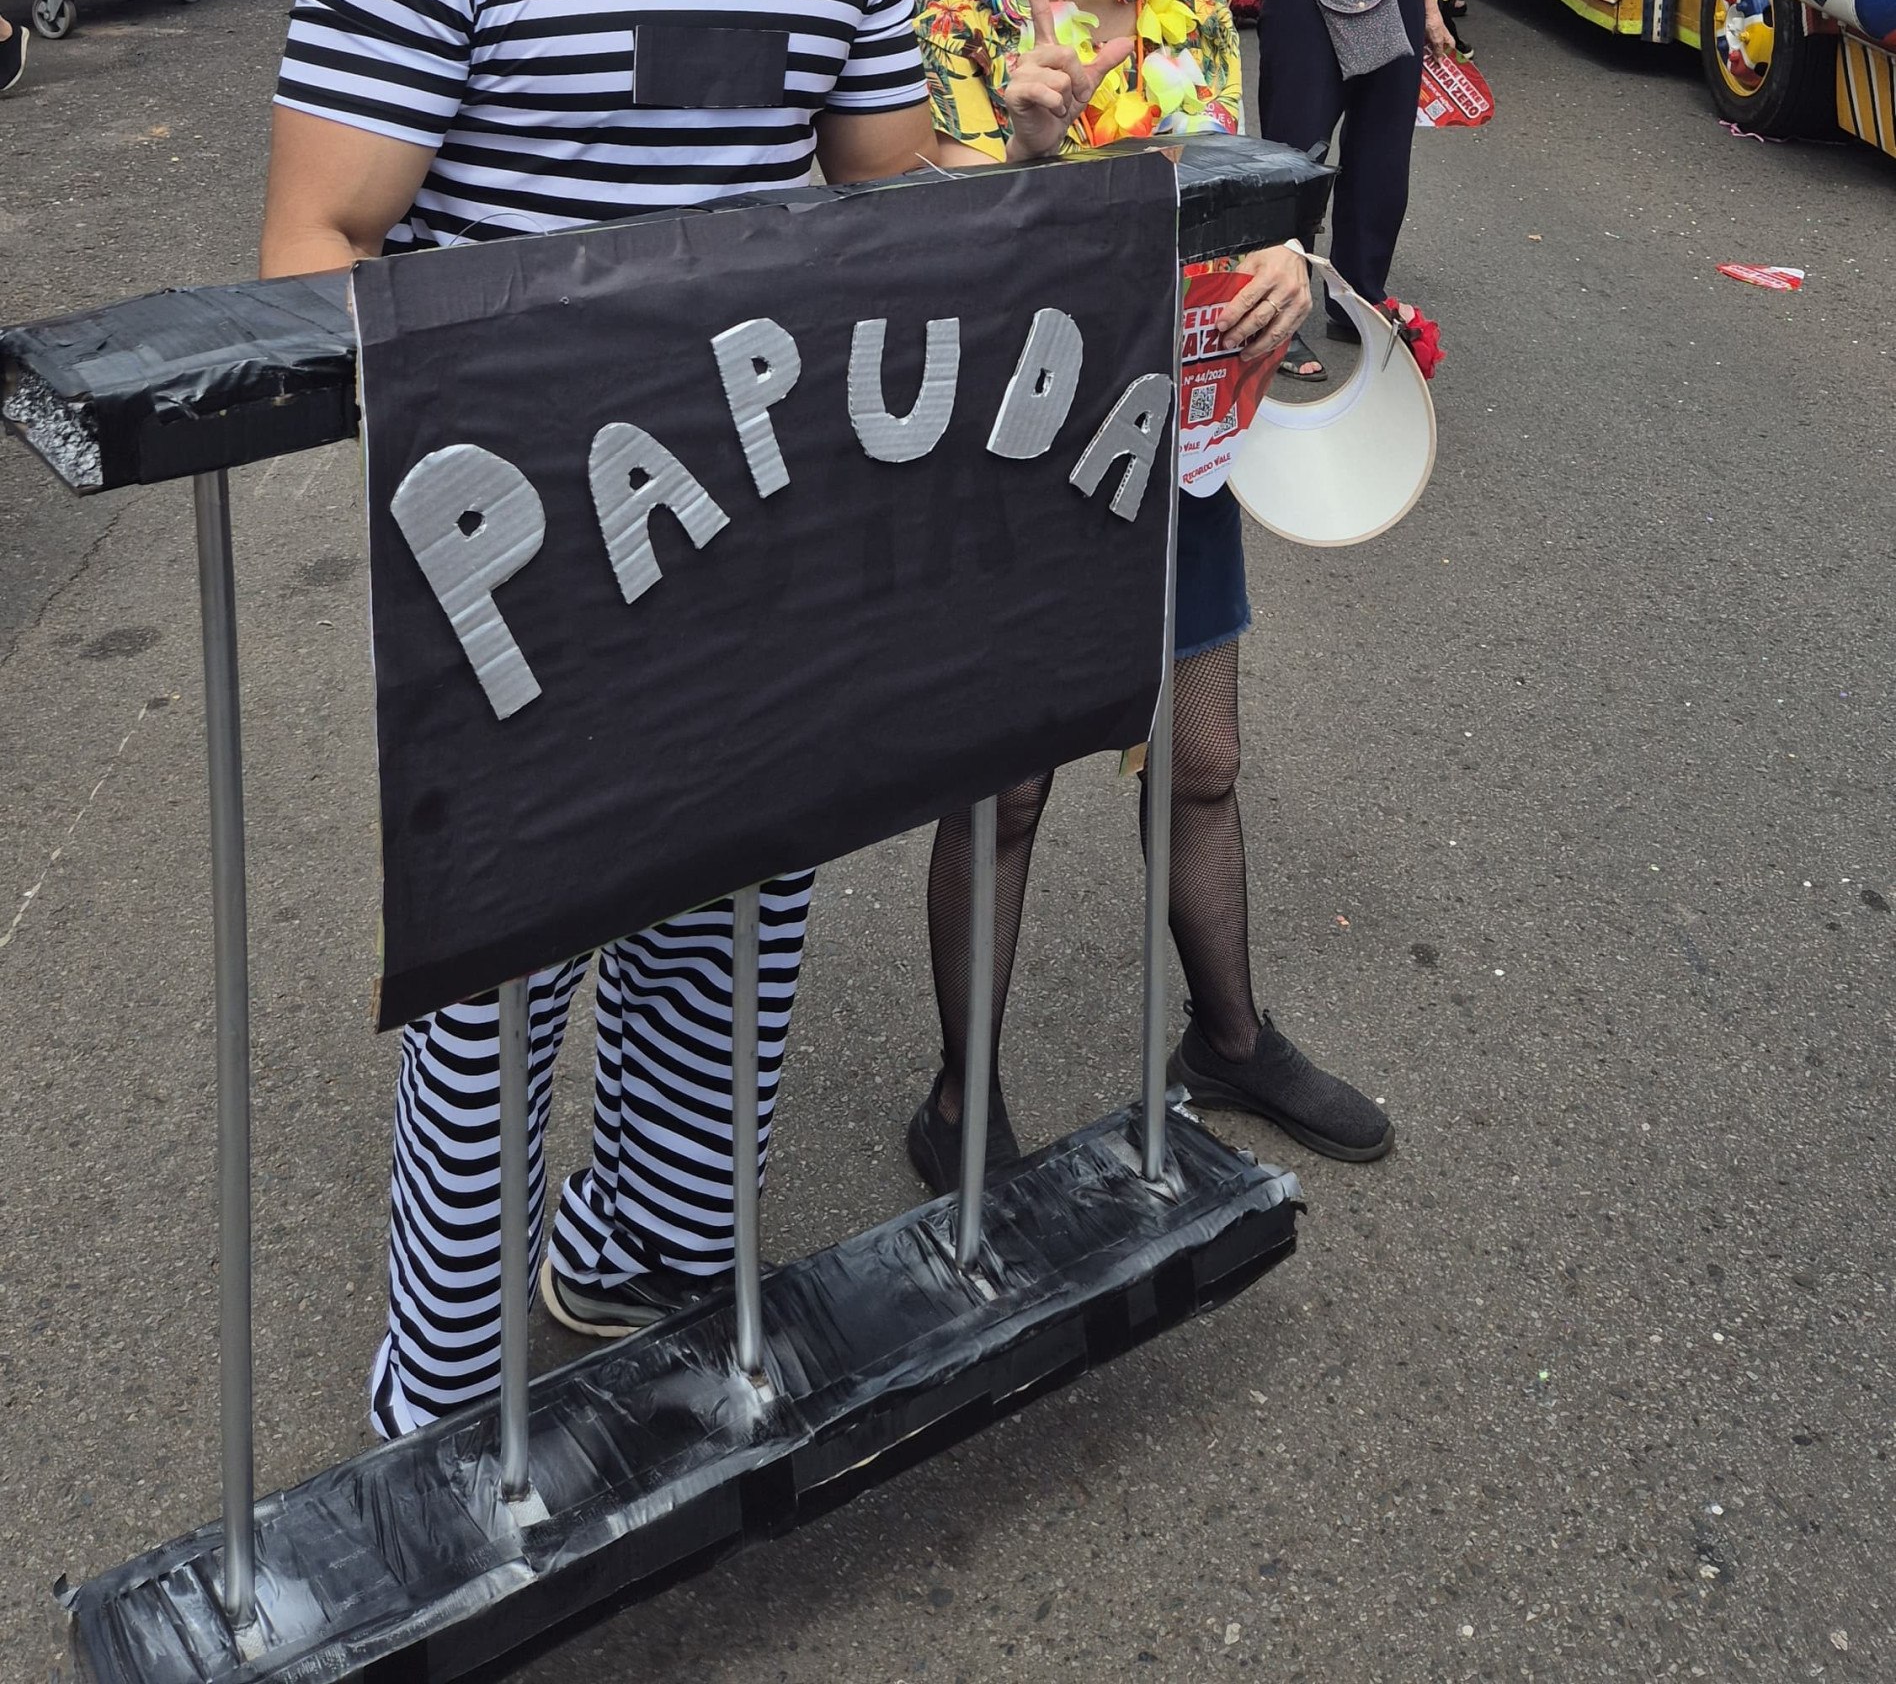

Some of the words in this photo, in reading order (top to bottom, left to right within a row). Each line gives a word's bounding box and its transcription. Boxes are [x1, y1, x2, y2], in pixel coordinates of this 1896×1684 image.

[1452, 88, 1480, 117] ZERO
[1459, 77, 1484, 104] LIVRE
[1213, 452, 1232, 466] VALE
[391, 308, 1176, 720] PAPUDA
